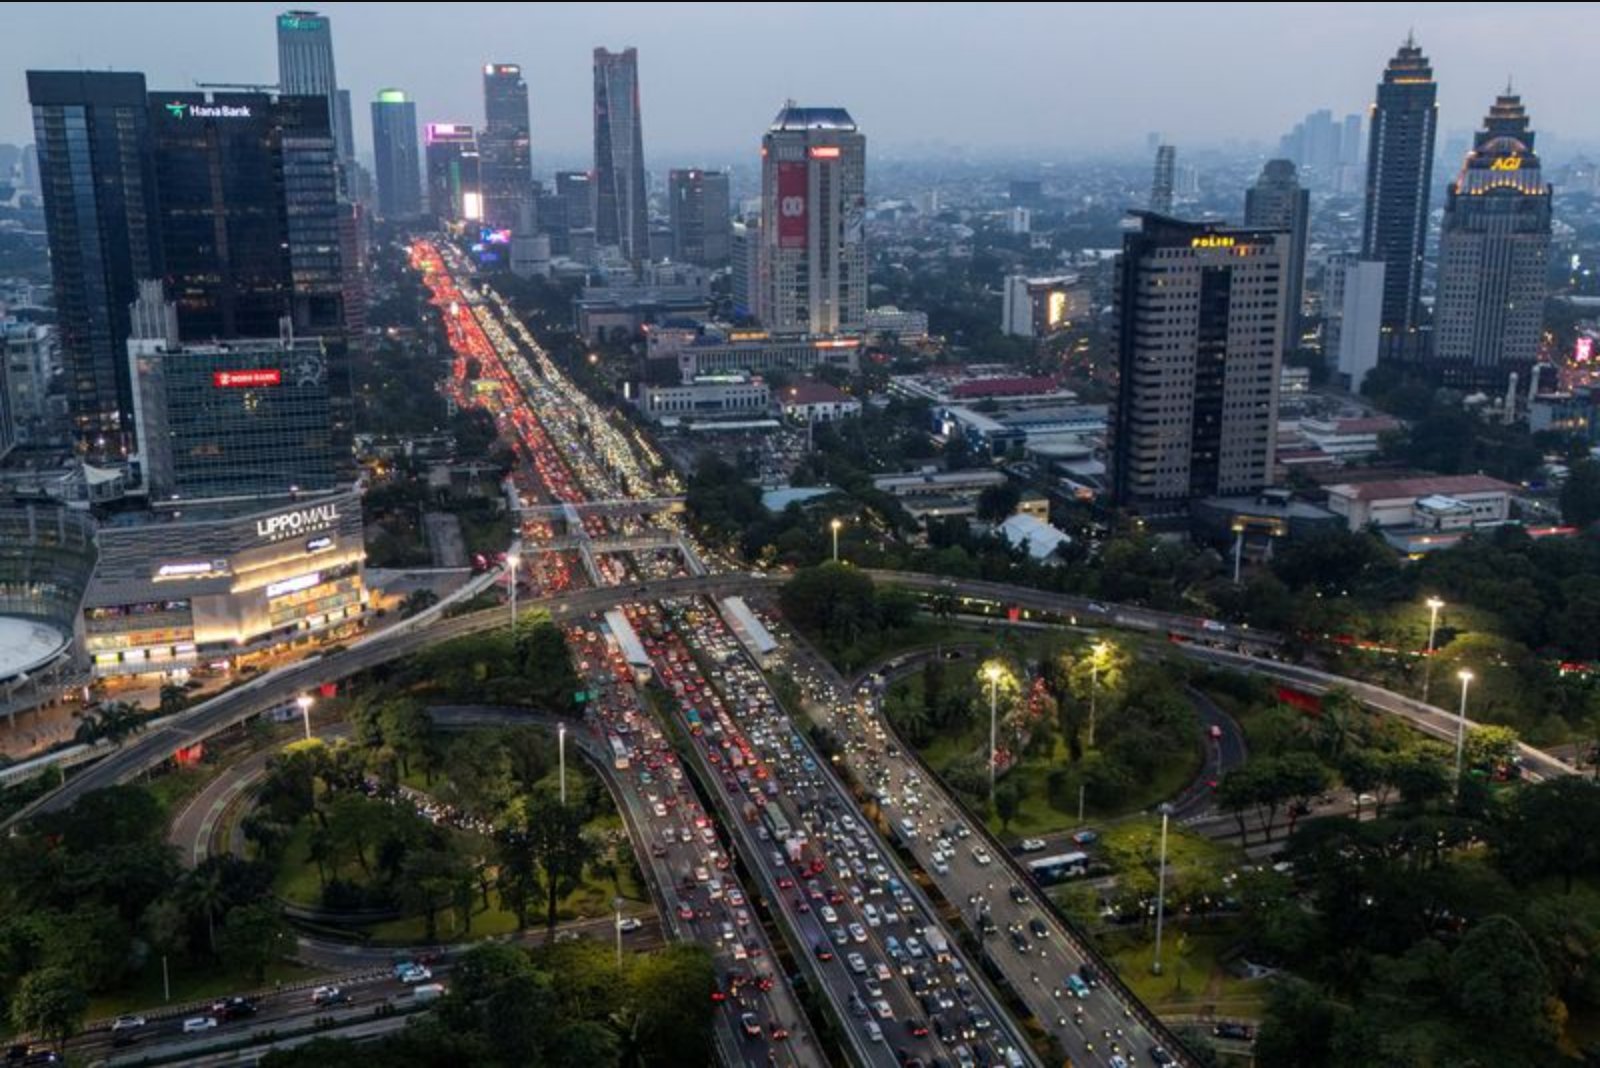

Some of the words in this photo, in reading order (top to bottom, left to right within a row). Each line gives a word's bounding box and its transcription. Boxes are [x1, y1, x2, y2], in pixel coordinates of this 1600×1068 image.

[189, 105, 221, 117] Hana
[221, 105, 251, 117] Bank
[1191, 234, 1235, 249] POLISI
